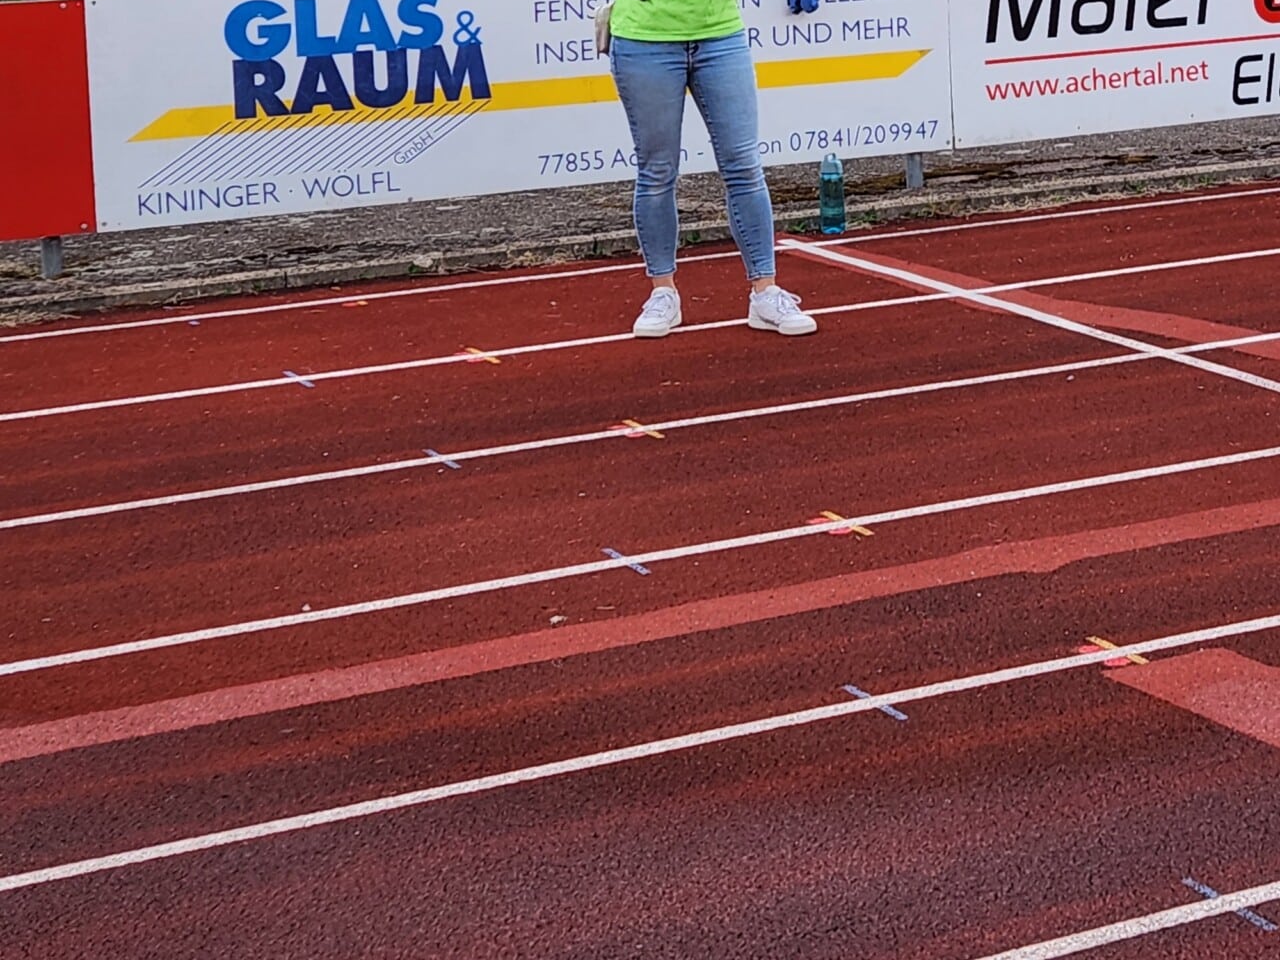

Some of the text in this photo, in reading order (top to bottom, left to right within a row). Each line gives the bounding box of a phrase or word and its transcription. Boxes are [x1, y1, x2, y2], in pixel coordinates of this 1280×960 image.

[453, 10, 482, 46] &
[772, 22, 832, 47] UND
[842, 17, 911, 42] MEHR
[232, 43, 492, 120] RAUM
[985, 60, 1209, 101] www.achertal.net
[393, 131, 434, 165] GmbH
[538, 150, 604, 175] 77855
[790, 119, 938, 152] 07841/209947
[138, 169, 401, 216] KININGER WÖLFL
